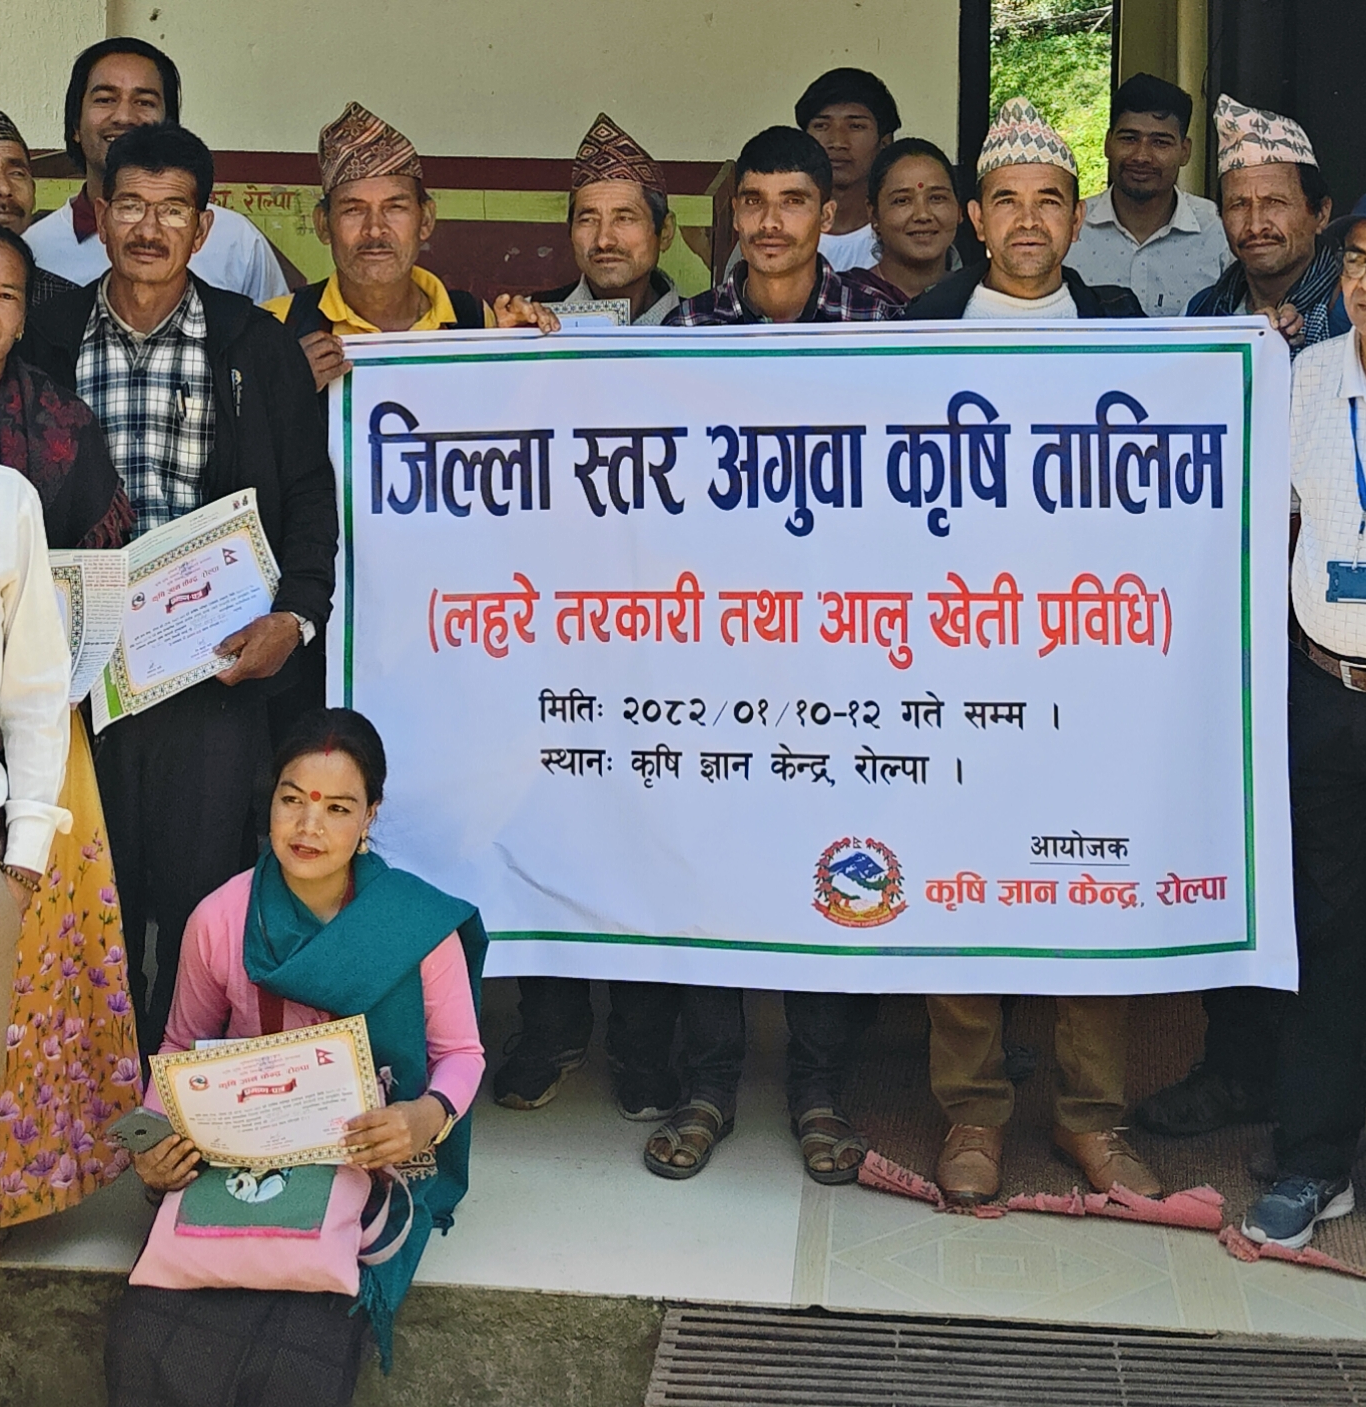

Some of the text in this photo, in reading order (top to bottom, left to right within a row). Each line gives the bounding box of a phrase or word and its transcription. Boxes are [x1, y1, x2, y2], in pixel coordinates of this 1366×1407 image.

[368, 390, 1229, 539] जिल्ला स्तर अगुवा कृषि तालिम
[428, 570, 1174, 672] (लहरे तरकारी तथा आलु खेती प्रविधि)
[901, 690, 947, 731] गते
[963, 700, 1029, 731] सम्म
[630, 743, 685, 790] कृषि
[699, 752, 755, 786] ज्ञान
[854, 745, 932, 786] रोल्पा
[1030, 830, 1131, 860] आयोजक
[925, 871, 988, 912] कृषि
[997, 879, 1060, 908] ज्ञान
[1155, 872, 1229, 907] रोल्पा
